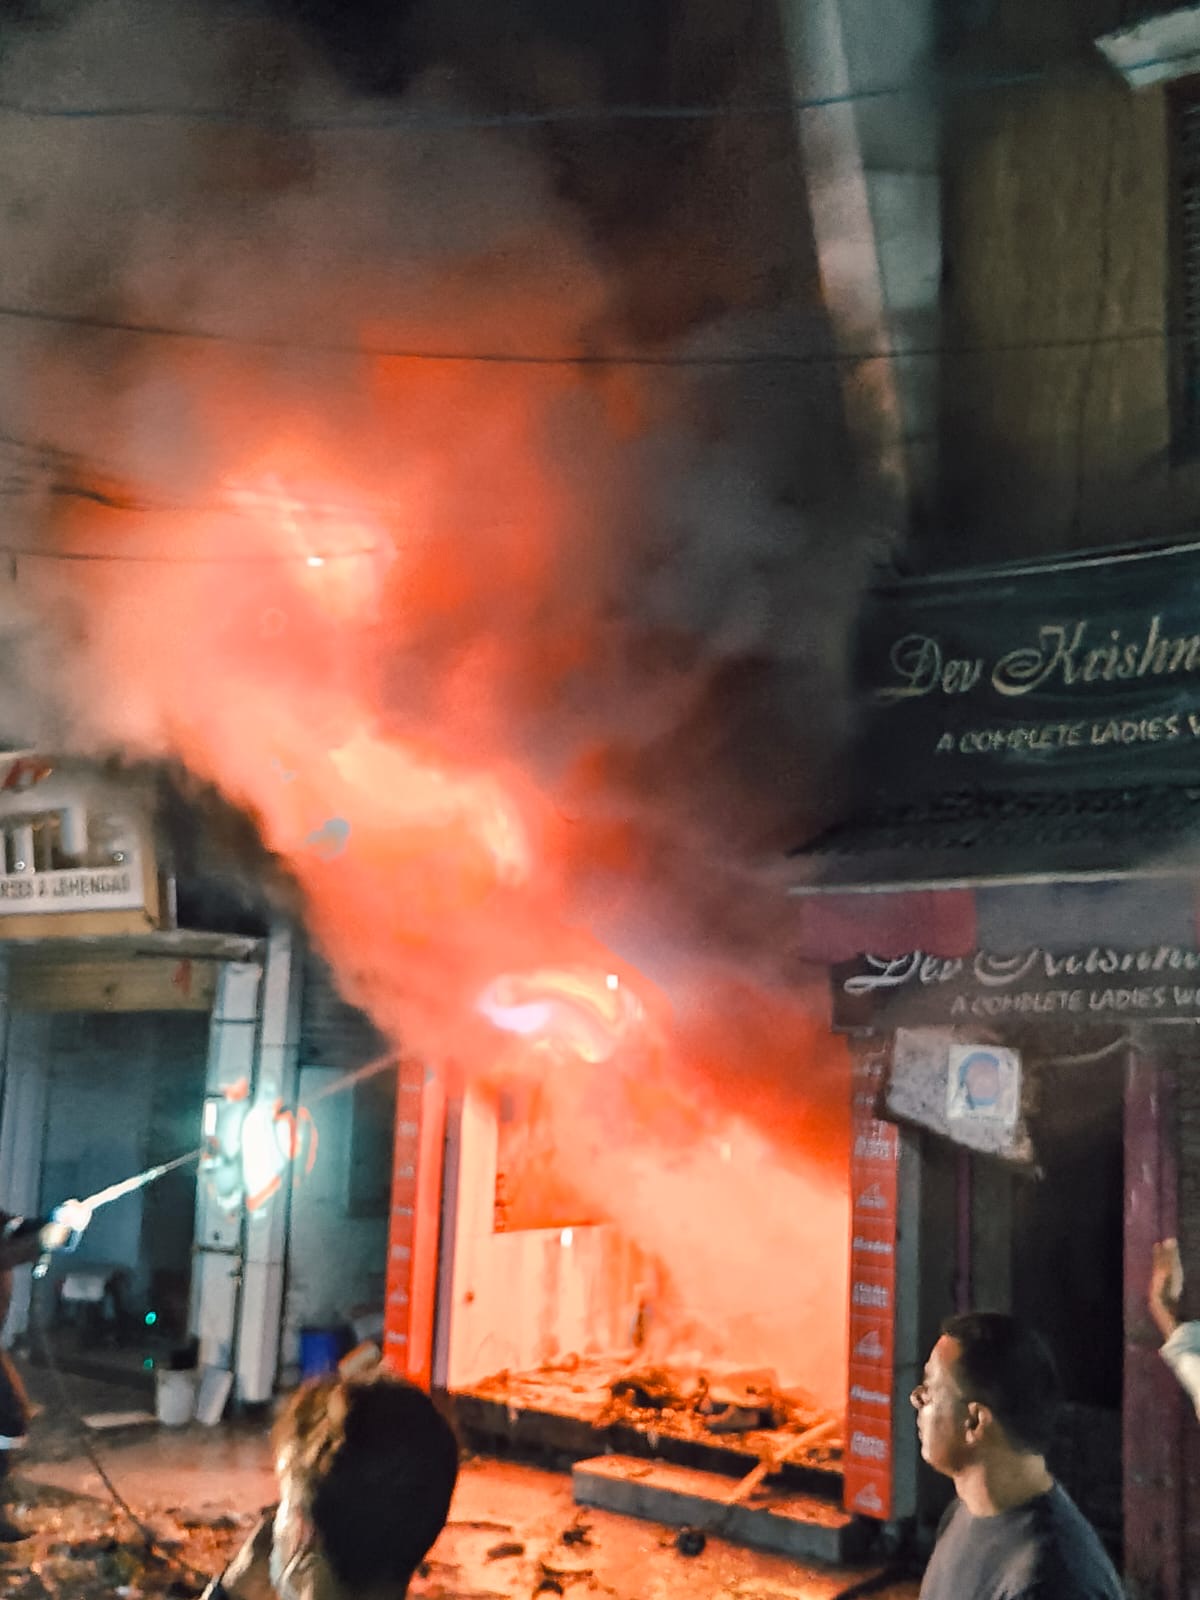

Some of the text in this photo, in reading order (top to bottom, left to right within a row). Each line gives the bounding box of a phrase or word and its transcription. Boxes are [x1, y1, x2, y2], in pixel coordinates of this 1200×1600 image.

[876, 634, 982, 698] Dev
[1090, 715, 1179, 746] LADIES
[971, 988, 1084, 1015] COMPLETE
[1088, 986, 1167, 1011] LADIES
